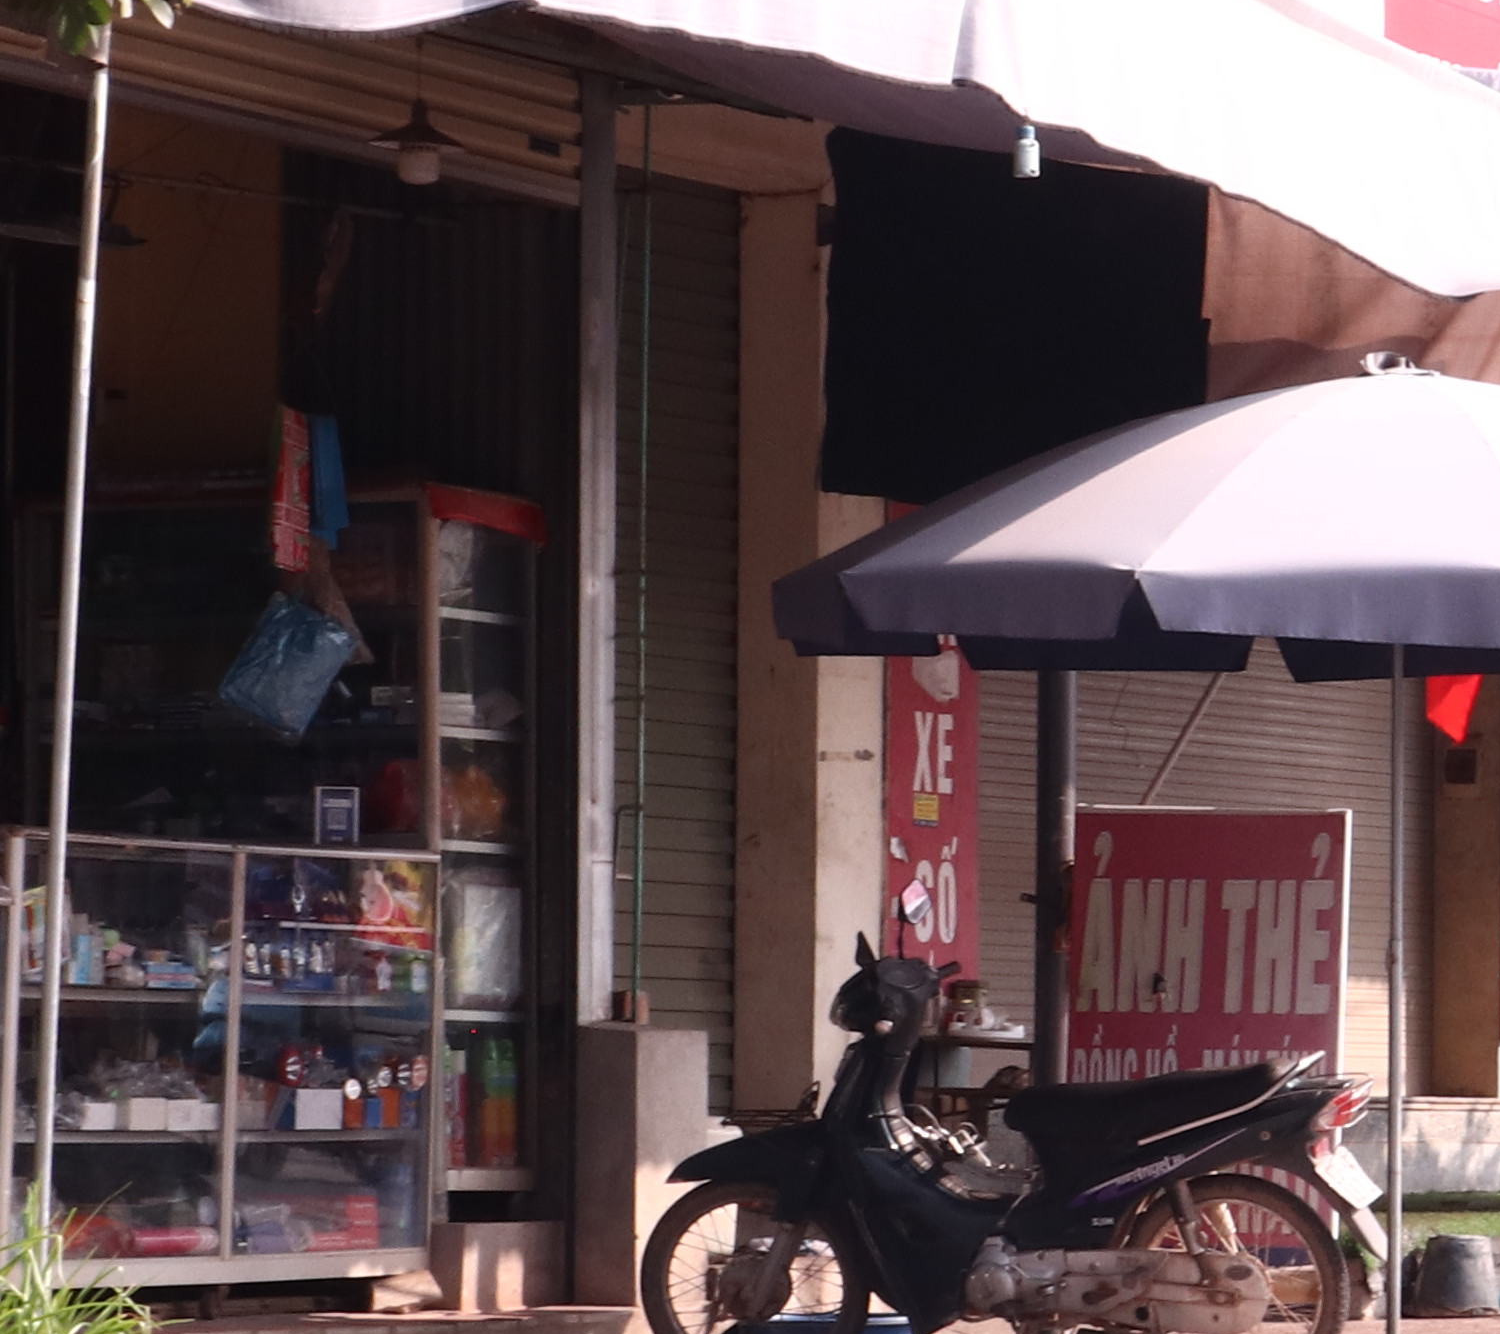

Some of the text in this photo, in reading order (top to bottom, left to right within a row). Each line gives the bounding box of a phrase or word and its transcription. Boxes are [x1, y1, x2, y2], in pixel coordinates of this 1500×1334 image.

[912, 710, 955, 794] XE
[913, 836, 957, 945] SỐ
[1075, 831, 1336, 1015] ẢNH THẺ
